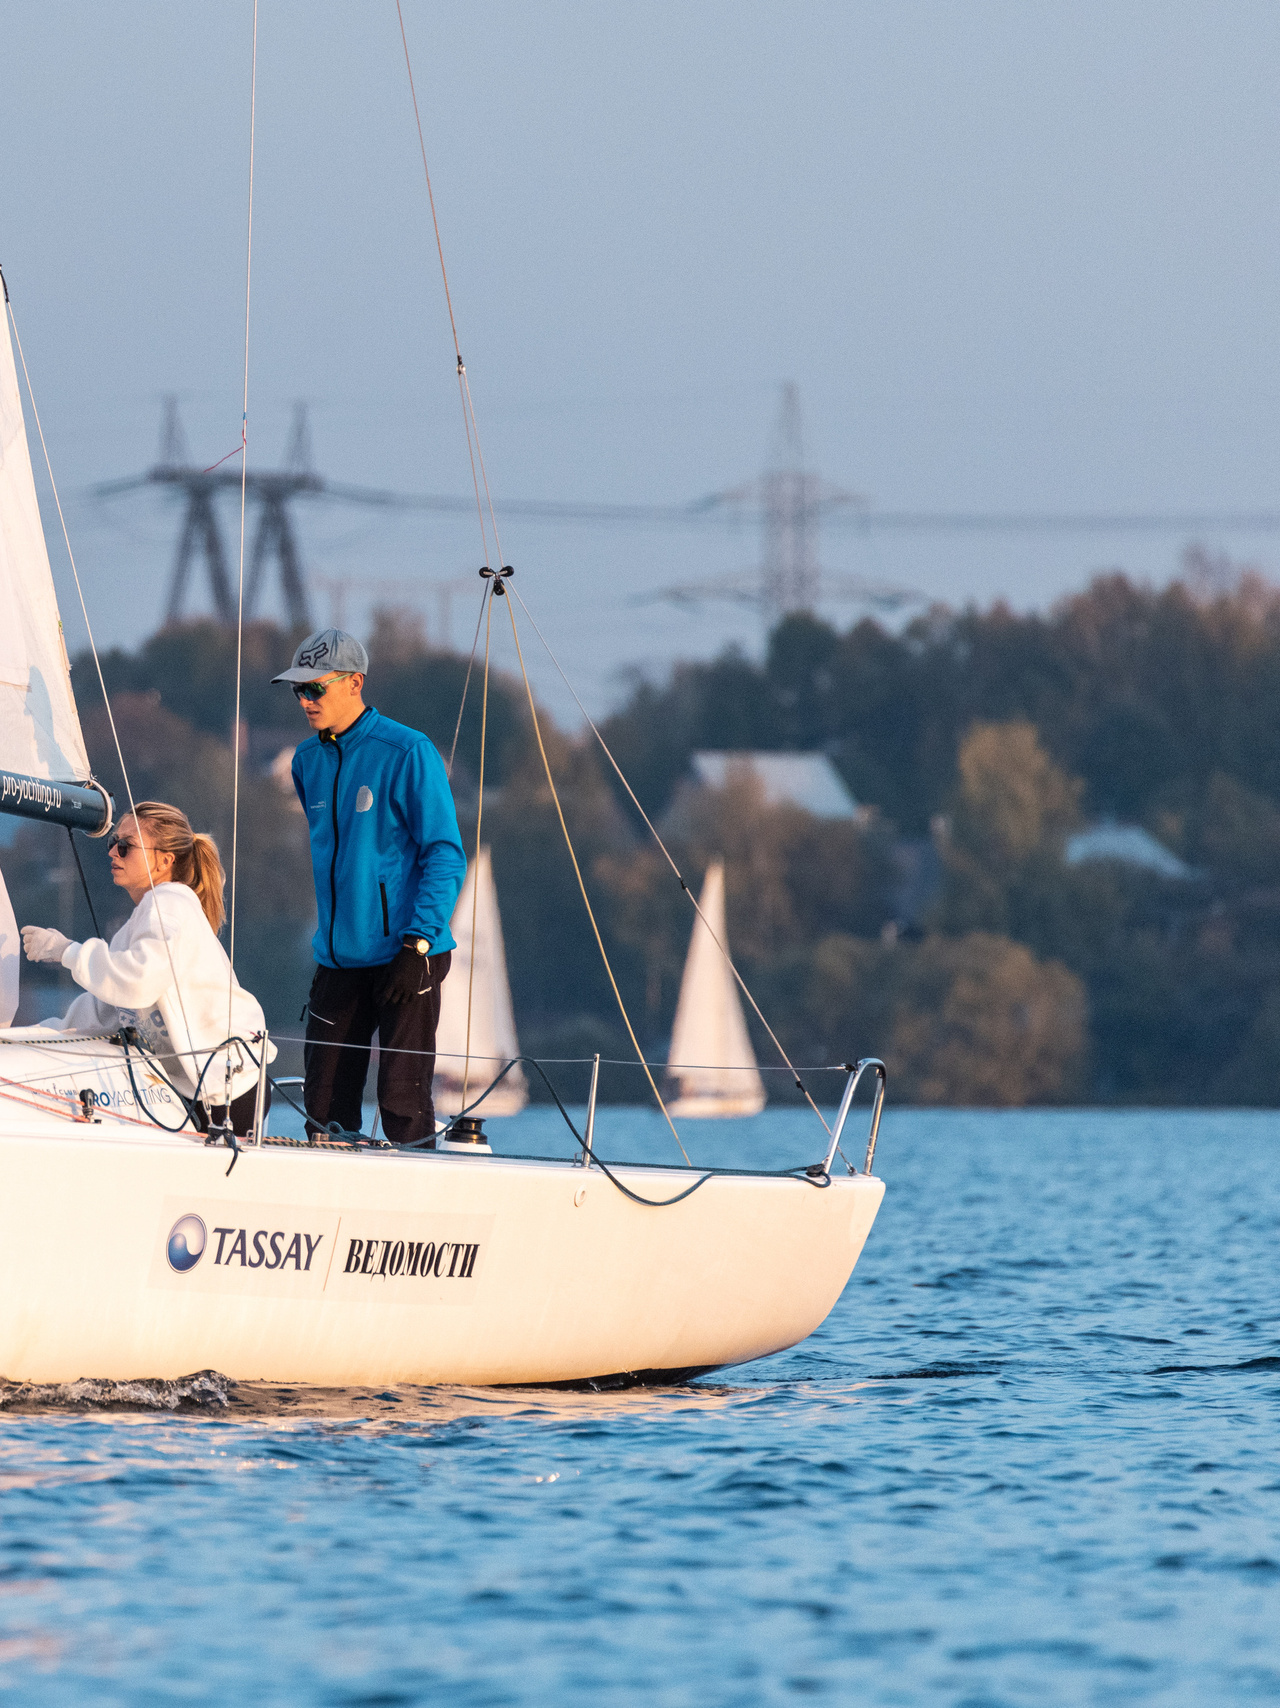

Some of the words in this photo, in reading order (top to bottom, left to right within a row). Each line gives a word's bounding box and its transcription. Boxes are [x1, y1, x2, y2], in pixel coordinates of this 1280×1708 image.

[1, 775, 62, 812] pro-yachting.ru
[92, 1087, 172, 1107] ROYACTING
[212, 1227, 324, 1271] TASSAY
[343, 1238, 480, 1283] ВЕДОМОСТИ
